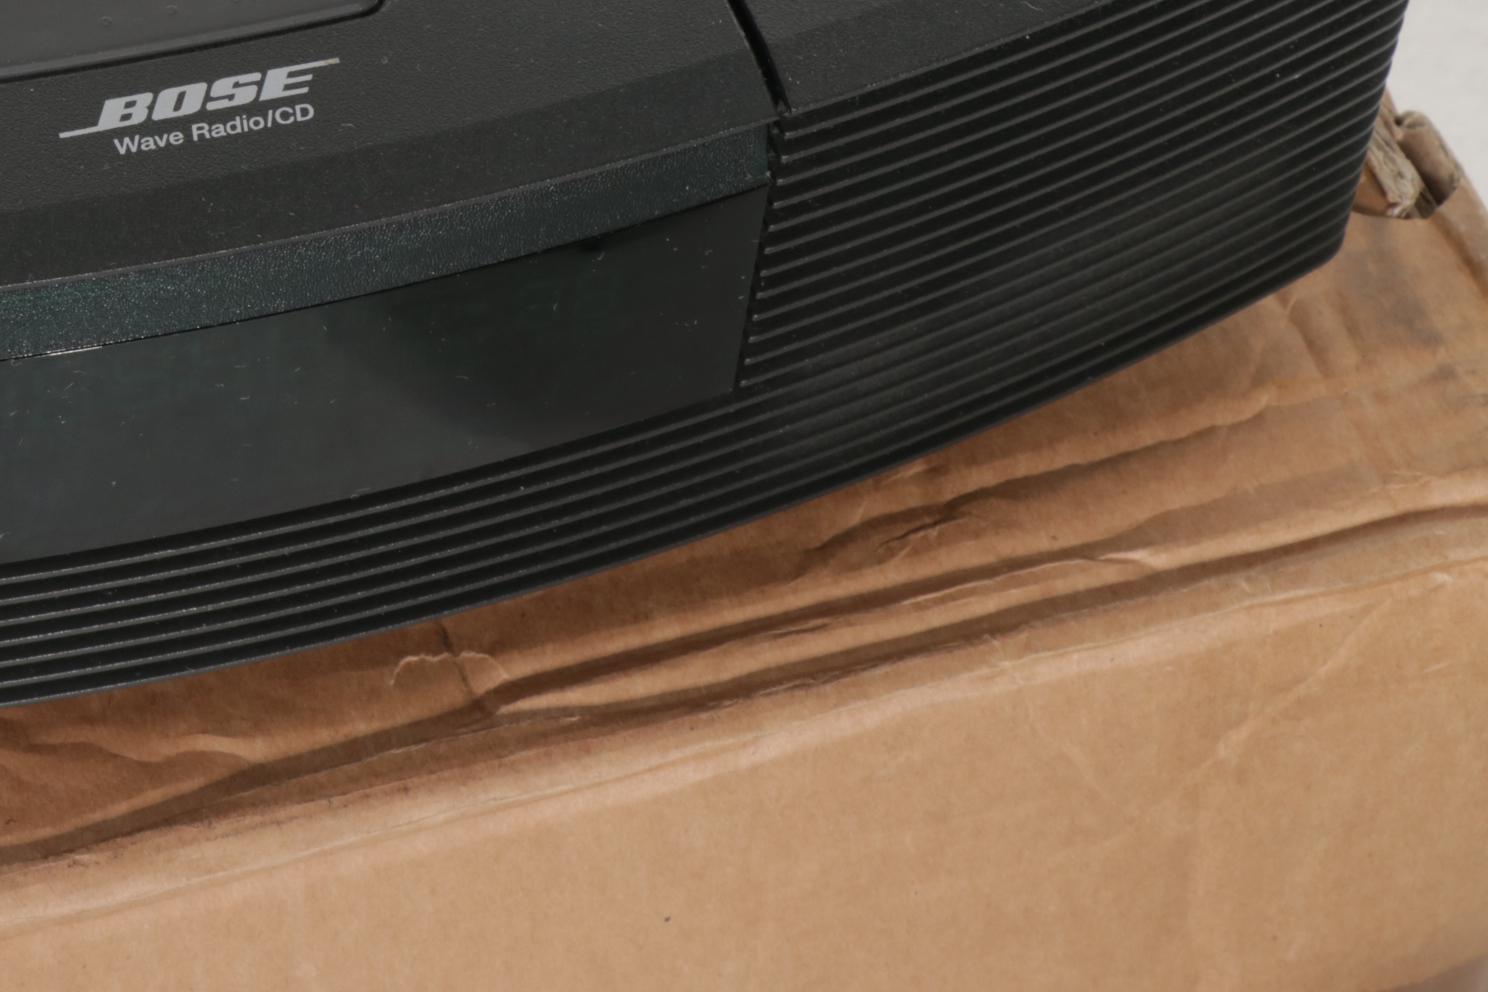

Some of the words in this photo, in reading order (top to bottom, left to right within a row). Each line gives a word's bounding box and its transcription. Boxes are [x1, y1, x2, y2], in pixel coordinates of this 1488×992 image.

[59, 57, 340, 138] BOSE
[114, 130, 185, 155] Wave
[192, 103, 315, 145] Radio/CD
